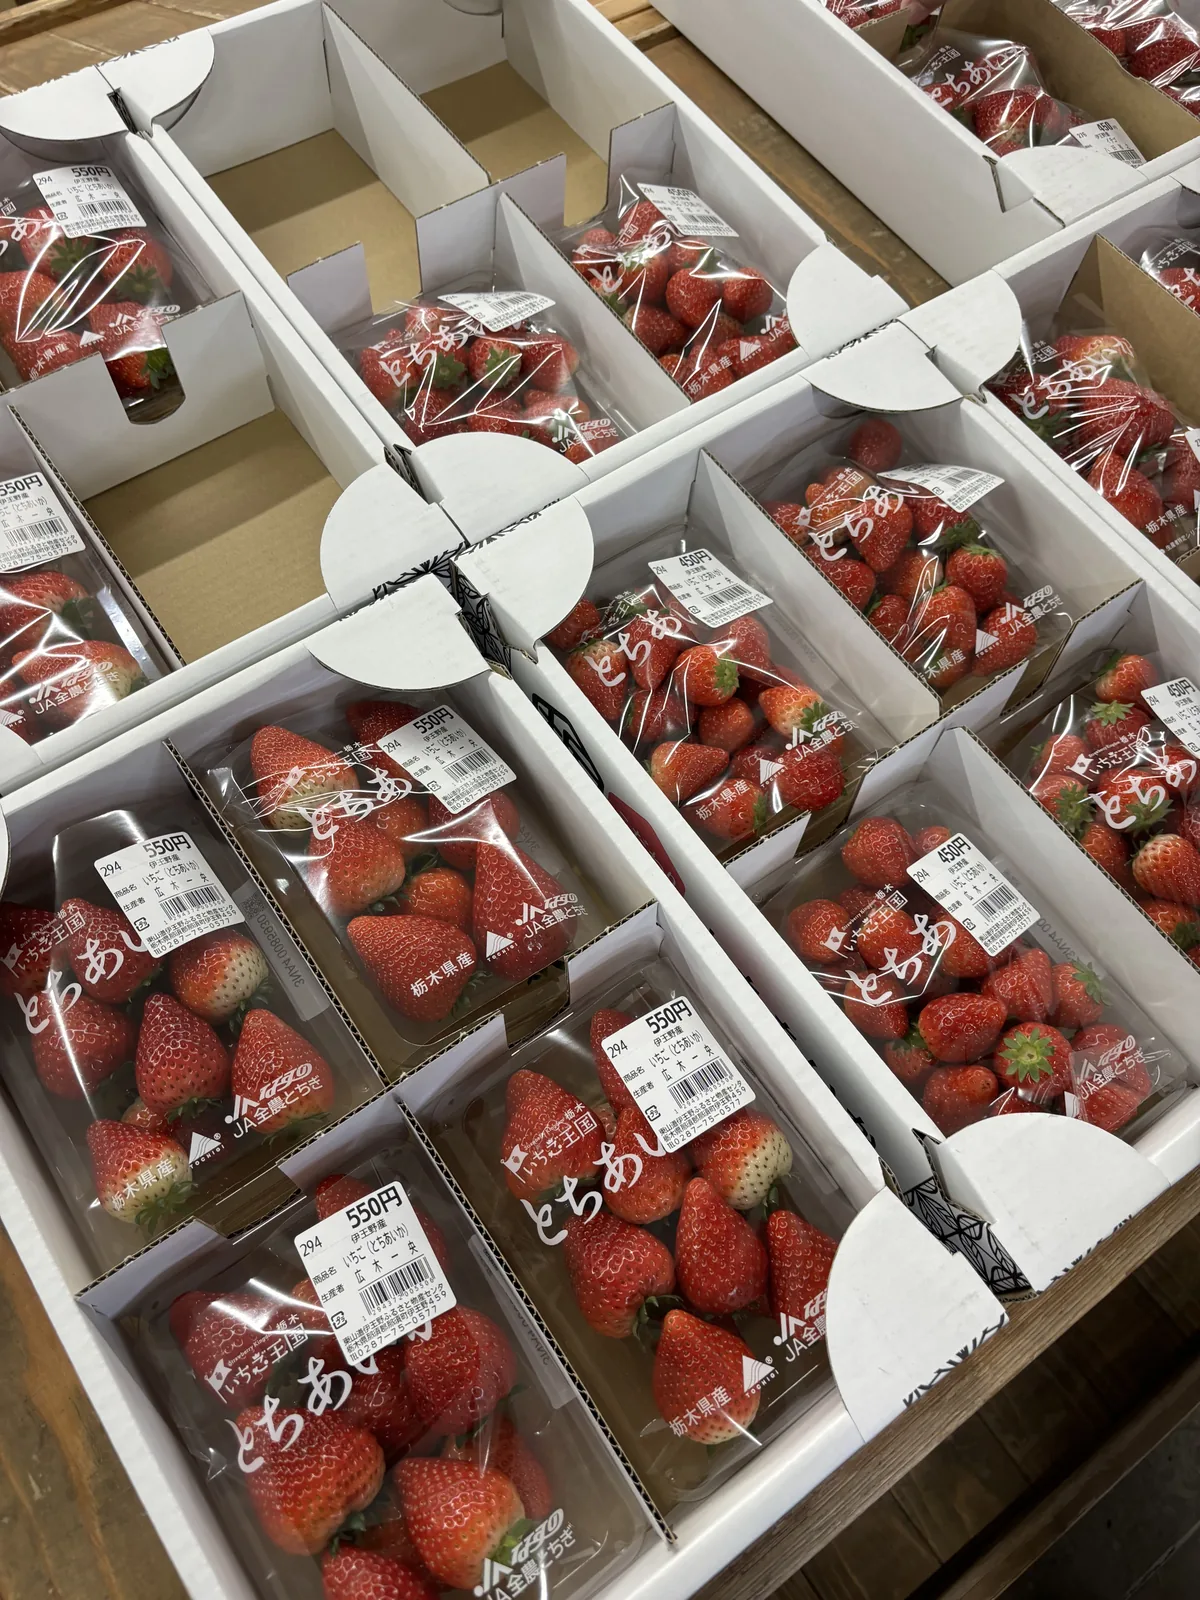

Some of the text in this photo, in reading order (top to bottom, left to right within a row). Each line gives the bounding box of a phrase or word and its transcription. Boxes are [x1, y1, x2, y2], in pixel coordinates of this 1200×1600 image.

[37, 176, 52, 185] 294
[71, 167, 112, 177] 550円
[688, 356, 732, 394] 栃木県産
[0, 475, 43, 497] 550円
[1146, 504, 1187, 534] 栃木県産
[679, 550, 712, 567] 450円
[1167, 679, 1195, 698] 450円
[413, 708, 454, 734] 550円
[383, 739, 402, 753] 294
[696, 779, 750, 821] 栃木県産
[143, 835, 191, 858] 550円
[938, 837, 971, 864] 450円
[100, 861, 122, 877] 294
[149, 854, 181, 868] 伊王野産
[913, 869, 930, 883] 294
[875, 883, 894, 900] 栃木
[56, 903, 76, 921] 栃木
[123, 897, 146, 912] 生産者
[844, 890, 908, 950] いちご王国
[16, 911, 86, 969] いちご王国
[410, 952, 474, 998] 栃木県産
[646, 1000, 692, 1034] 550円
[654, 1026, 683, 1047] 伊王野産
[607, 1040, 628, 1058] 294
[623, 1066, 645, 1083] 商品名
[1080, 1049, 1146, 1100] JA全農とちぎ
[633, 1082, 654, 1098] 生産者
[233, 1076, 323, 1138] JA全農とちぎ
[564, 1102, 586, 1121] 栃木
[524, 1112, 597, 1176] いちご王国
[190, 1144, 225, 1168] TOCHIGI
[112, 1158, 176, 1211] 栃木県産
[346, 1186, 402, 1229] 550円
[351, 1219, 387, 1243] 伊王野産
[300, 1236, 322, 1256] 294
[312, 1266, 337, 1285] 商品名
[321, 1284, 345, 1303] 生産者
[276, 1313, 300, 1332] 栃木
[225, 1322, 309, 1395] いちご王国
[746, 1370, 779, 1398] TOCHIGI
[669, 1385, 731, 1437] 栃木県産
